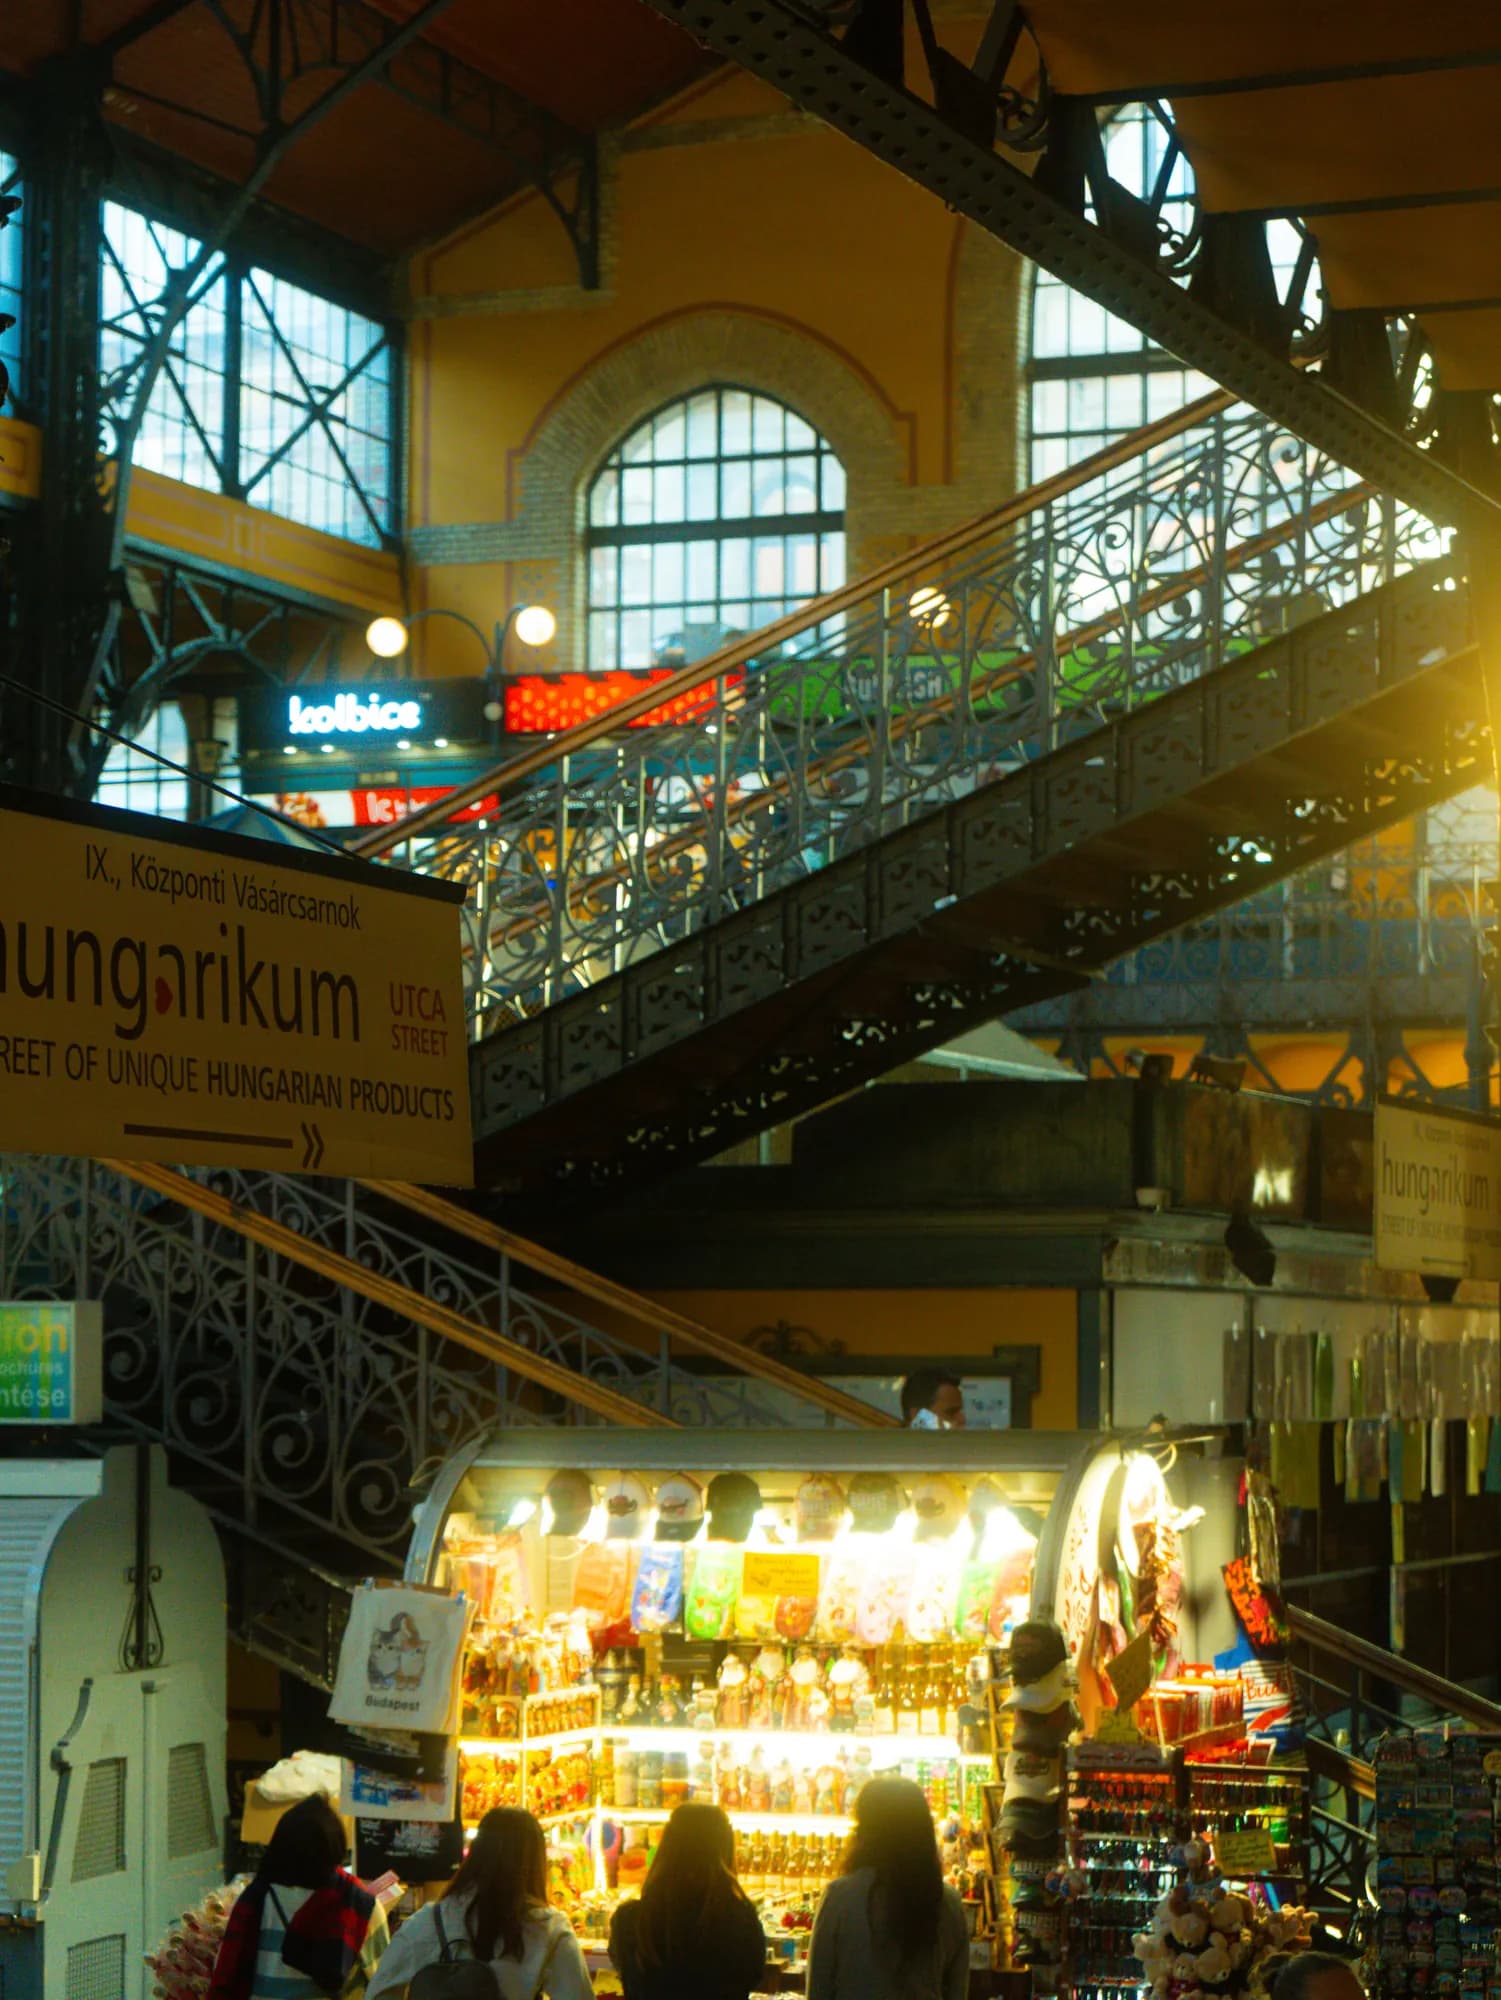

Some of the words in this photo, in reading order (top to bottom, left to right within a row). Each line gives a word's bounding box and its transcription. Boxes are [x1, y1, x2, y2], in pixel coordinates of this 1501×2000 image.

[289, 692, 421, 734] kolbice
[85, 844, 121, 890] IX.,
[131, 852, 226, 905] Központi
[233, 872, 361, 931] Vásárcsarnok
[390, 981, 447, 1024] UTCA
[391, 1023, 450, 1057] STREET
[65, 1043, 98, 1082] OF
[107, 1047, 199, 1096] UNIQUE
[207, 1060, 343, 1110] HUNGARIAN
[350, 1078, 455, 1122] PRODUCTS
[1382, 1141, 1490, 1216] hungarikum
[365, 1695, 420, 1713] Budapest
